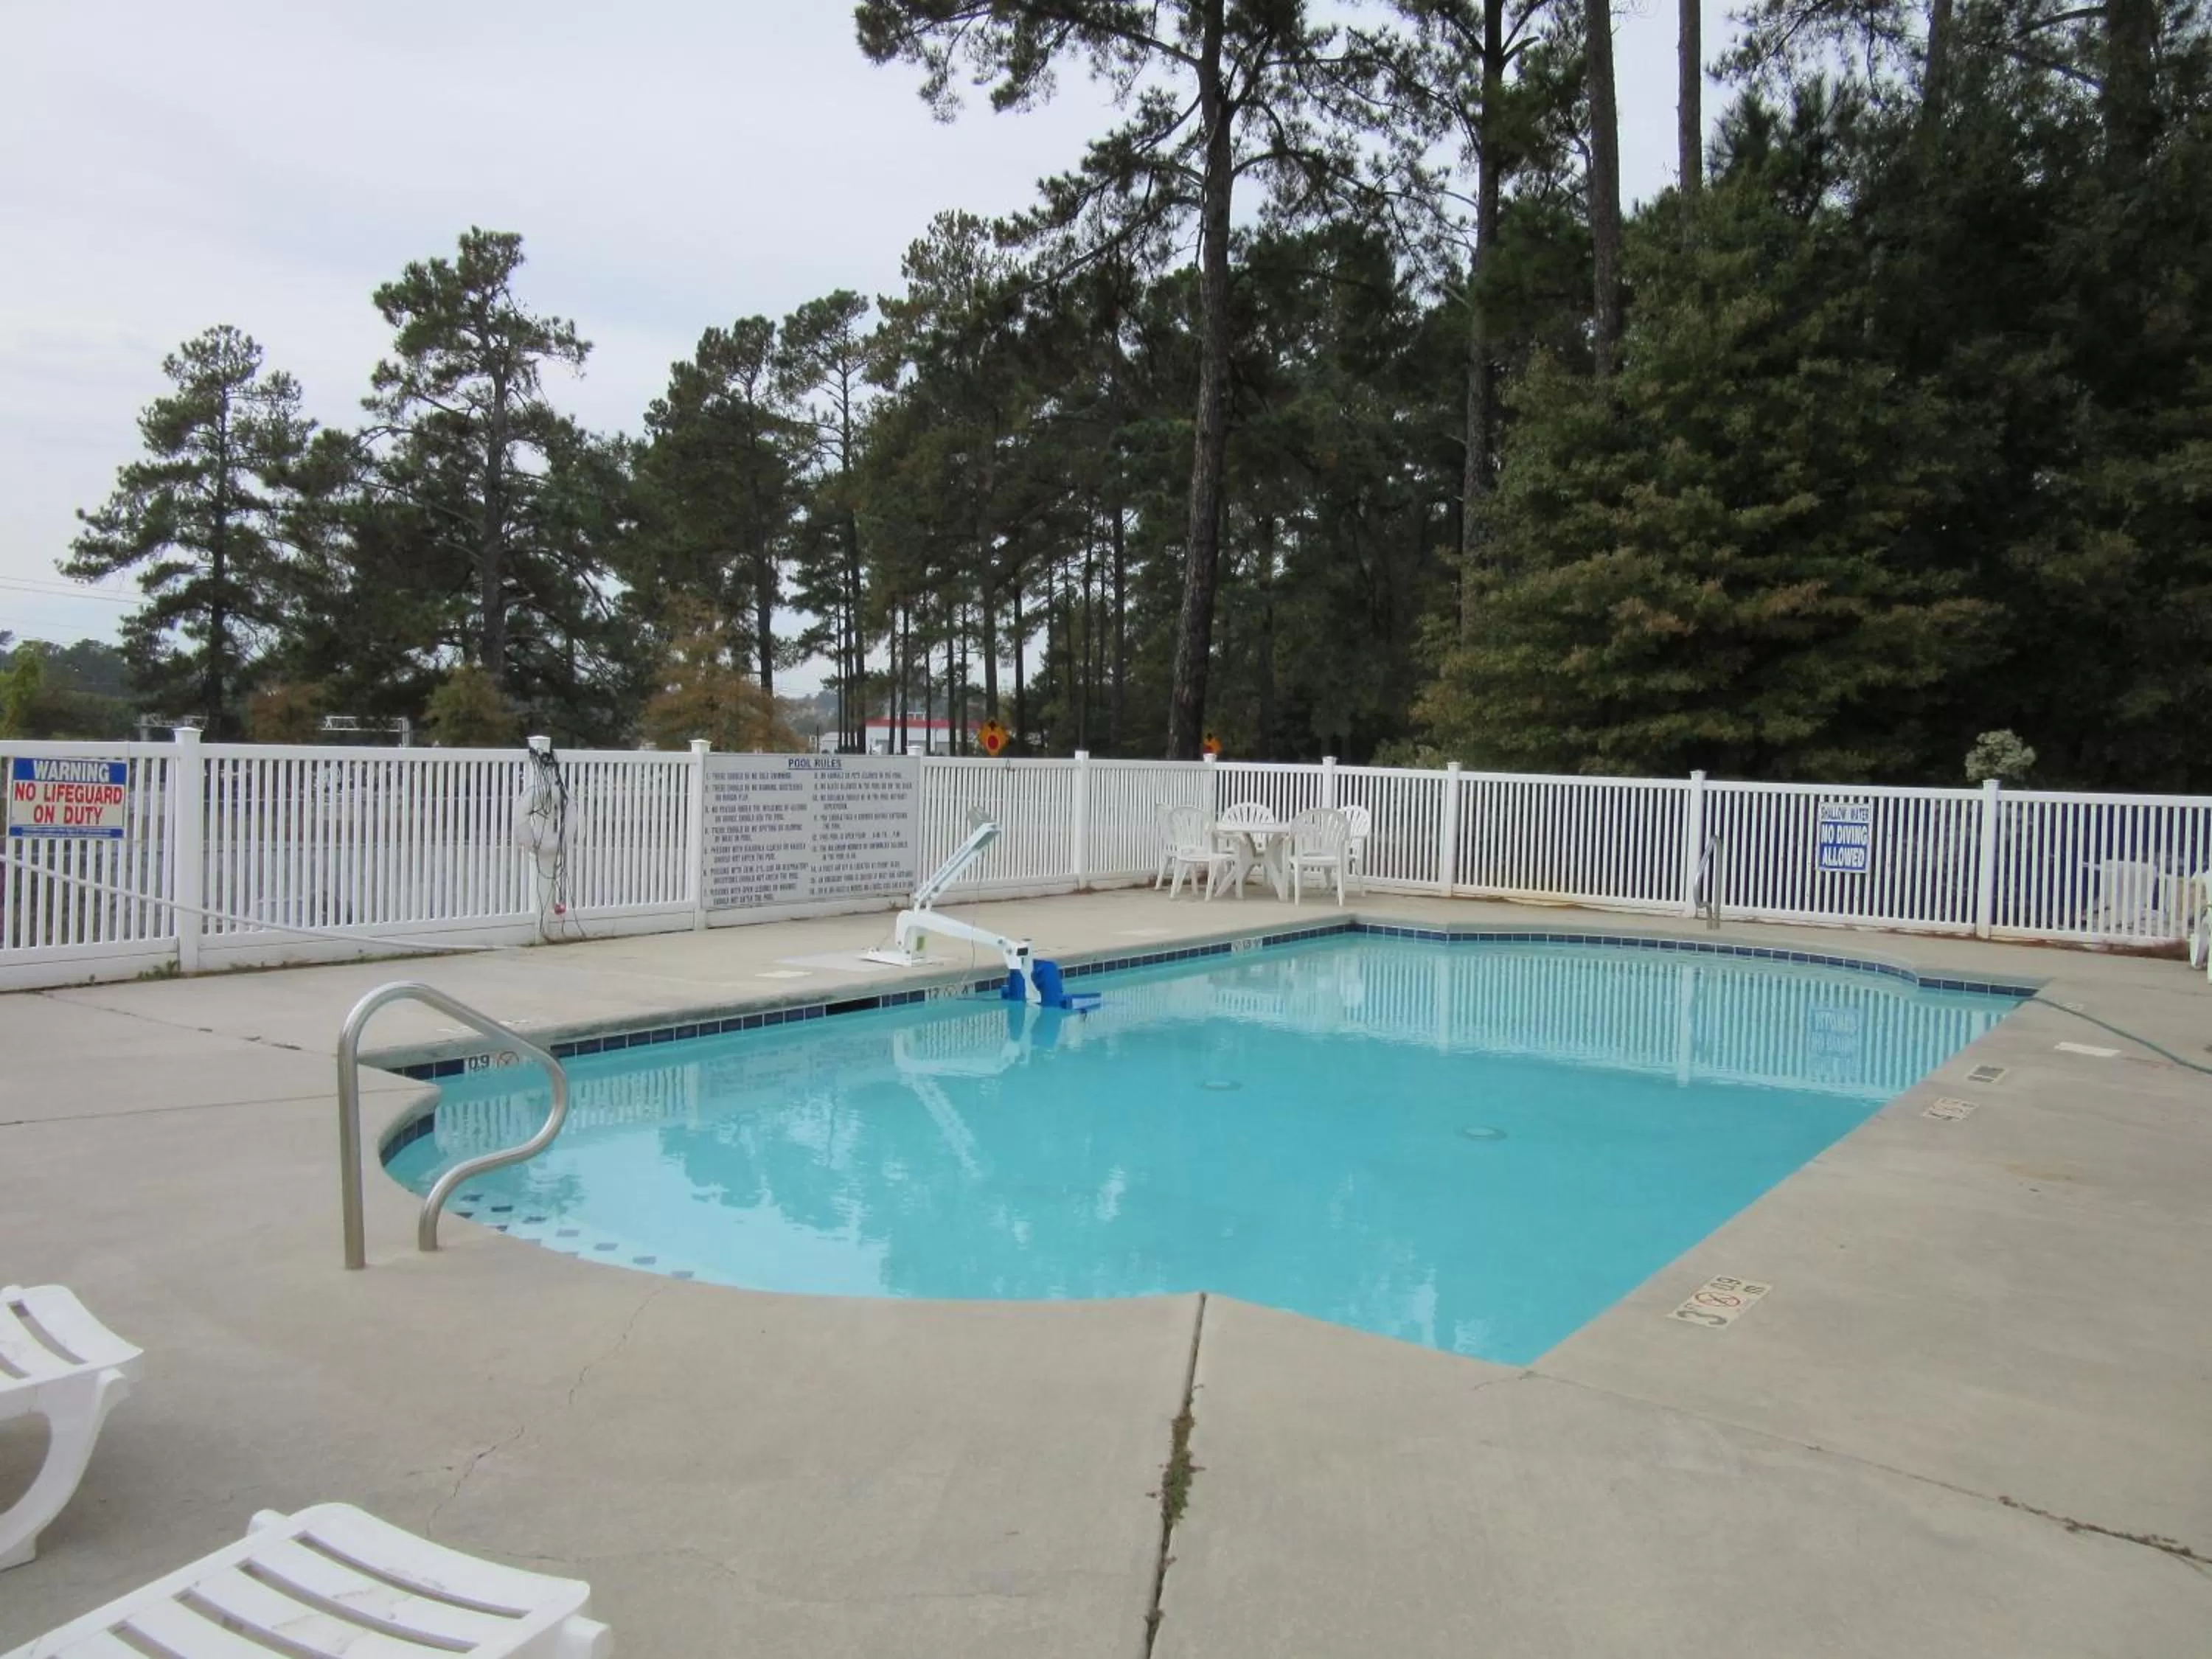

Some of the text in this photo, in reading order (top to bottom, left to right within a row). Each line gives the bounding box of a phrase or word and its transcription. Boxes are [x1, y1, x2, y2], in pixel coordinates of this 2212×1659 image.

[34, 759, 110, 782] WARNING
[787, 758, 841, 768] POOL RULES
[15, 783, 122, 804] NO LIFEGUARD
[34, 805, 103, 824] ON DUTY
[1820, 824, 1868, 846] NO DIVING
[1822, 846, 1865, 868] ALLOWED
